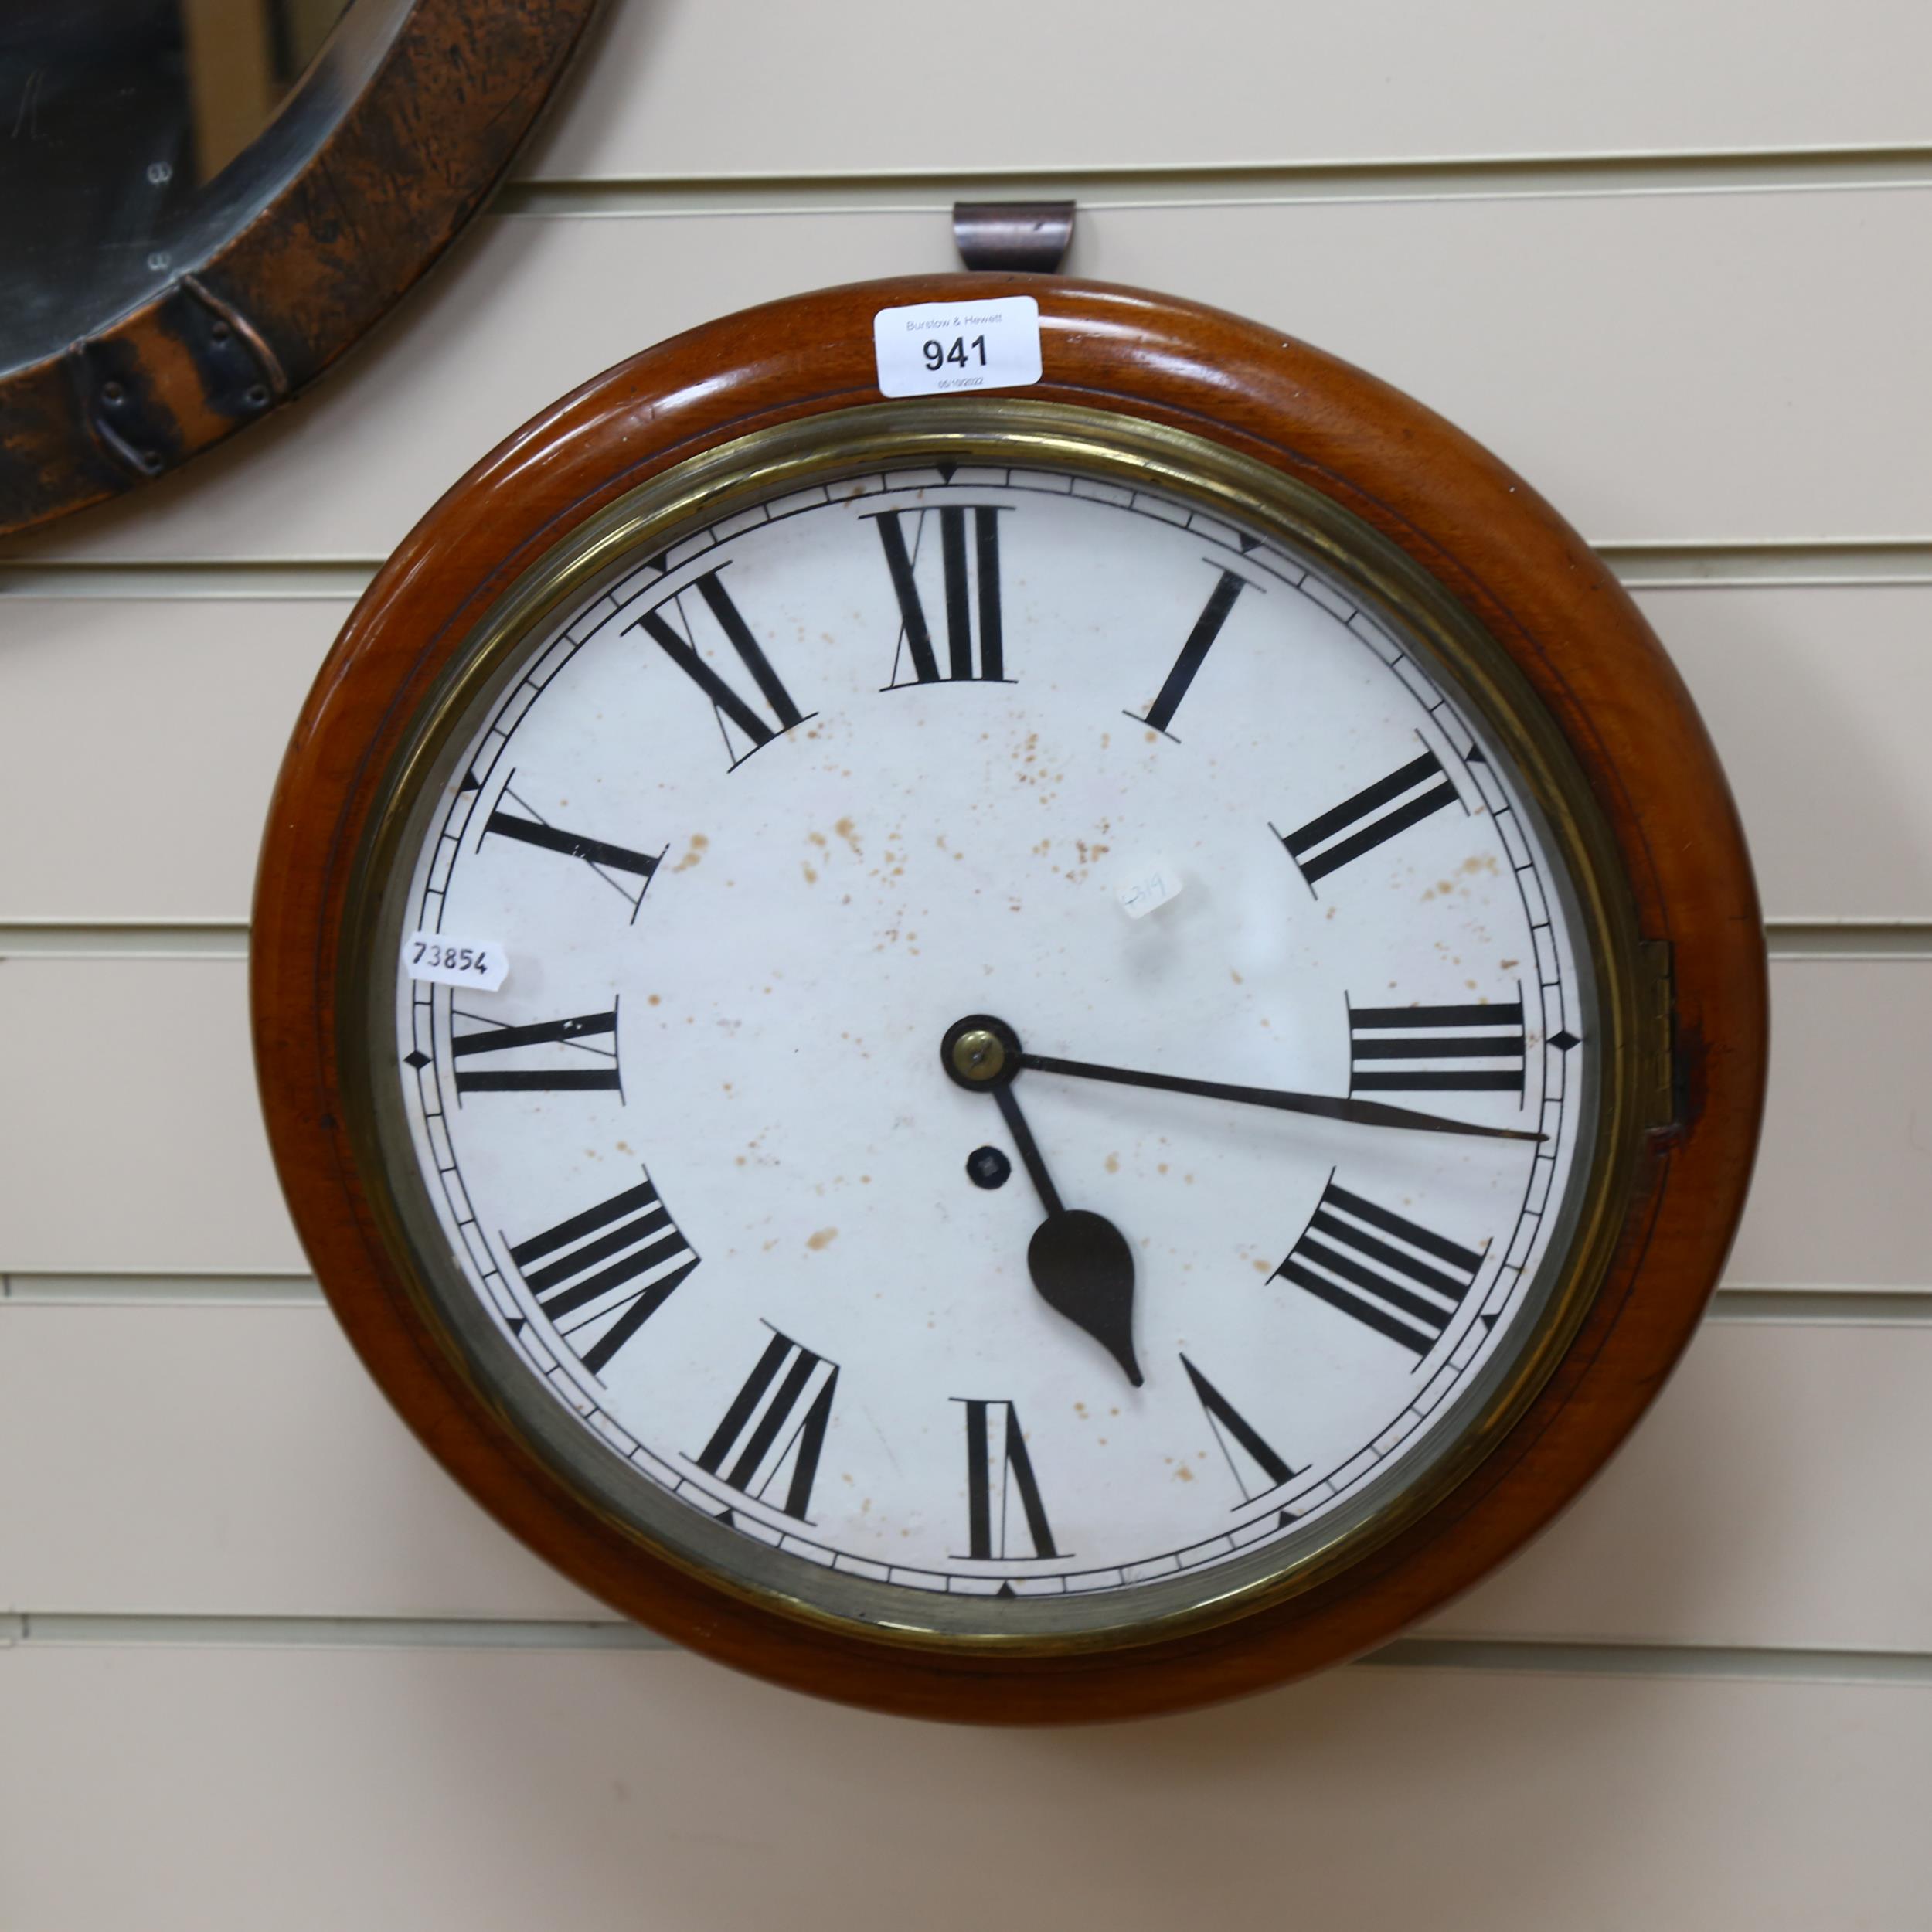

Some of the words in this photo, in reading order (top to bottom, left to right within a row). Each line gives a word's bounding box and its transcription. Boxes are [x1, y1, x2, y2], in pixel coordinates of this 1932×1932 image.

[906, 319, 950, 332] Burstow
[953, 318, 961, 327] &
[964, 313, 1003, 325] Hewett
[923, 335, 987, 371] 941
[621, 560, 819, 773] XI
[858, 505, 1018, 692] XII
[1122, 558, 1267, 743] I
[475, 767, 670, 926] X
[1267, 728, 1471, 901] II
[412, 941, 488, 975] 73854
[451, 988, 625, 1109] IX
[1344, 979, 1526, 1111] III
[498, 1163, 702, 1390] VIII
[1264, 1165, 1492, 1375] IIII
[679, 1318, 841, 1527] VII
[948, 1397, 1075, 1560] VI
[1179, 1352, 1312, 1512] V
